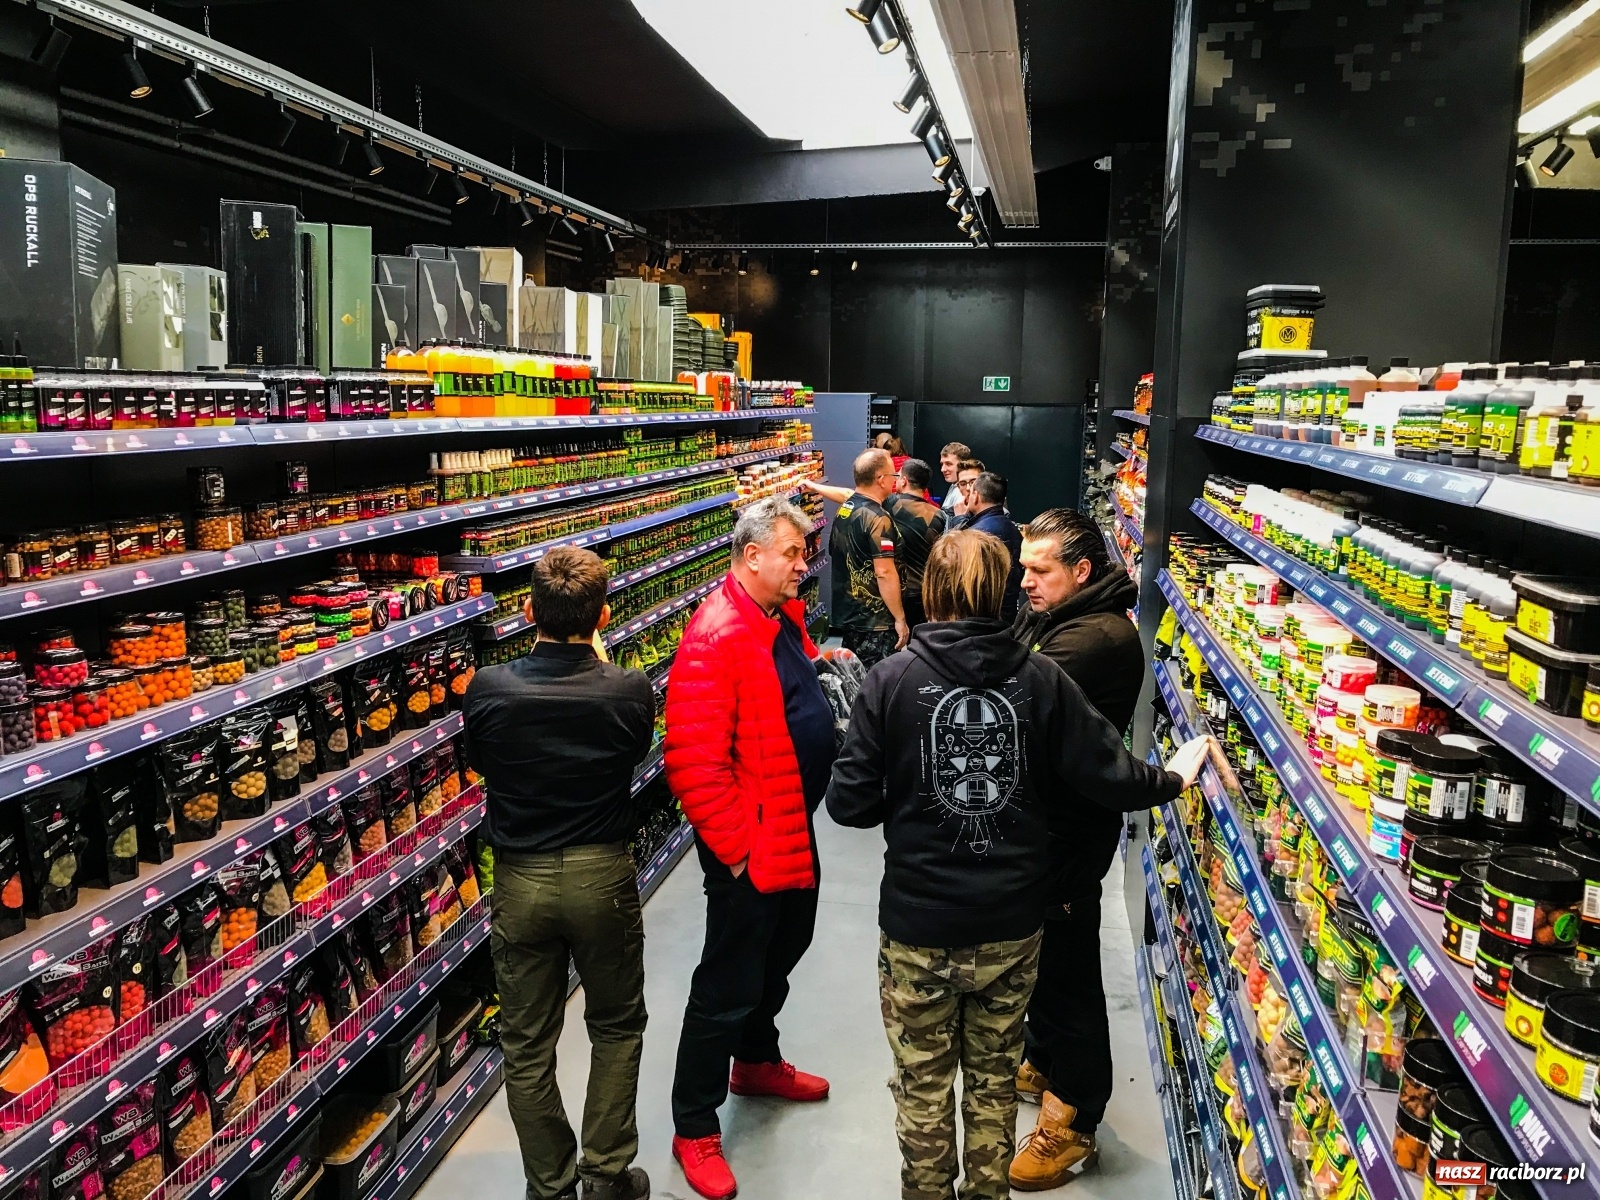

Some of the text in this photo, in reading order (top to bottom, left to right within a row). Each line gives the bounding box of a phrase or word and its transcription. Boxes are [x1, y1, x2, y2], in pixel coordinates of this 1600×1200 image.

[25, 174, 39, 268] OPS RUCKALL
[257, 1001, 274, 1015] WB
[1460, 1022, 1488, 1061] NIKL
[115, 1108, 139, 1125] WB
[103, 1124, 135, 1143] WARMUZ
[1518, 1109, 1551, 1157] NIKL
[67, 1147, 88, 1166] WB
[53, 1164, 86, 1186] WARMUZ
